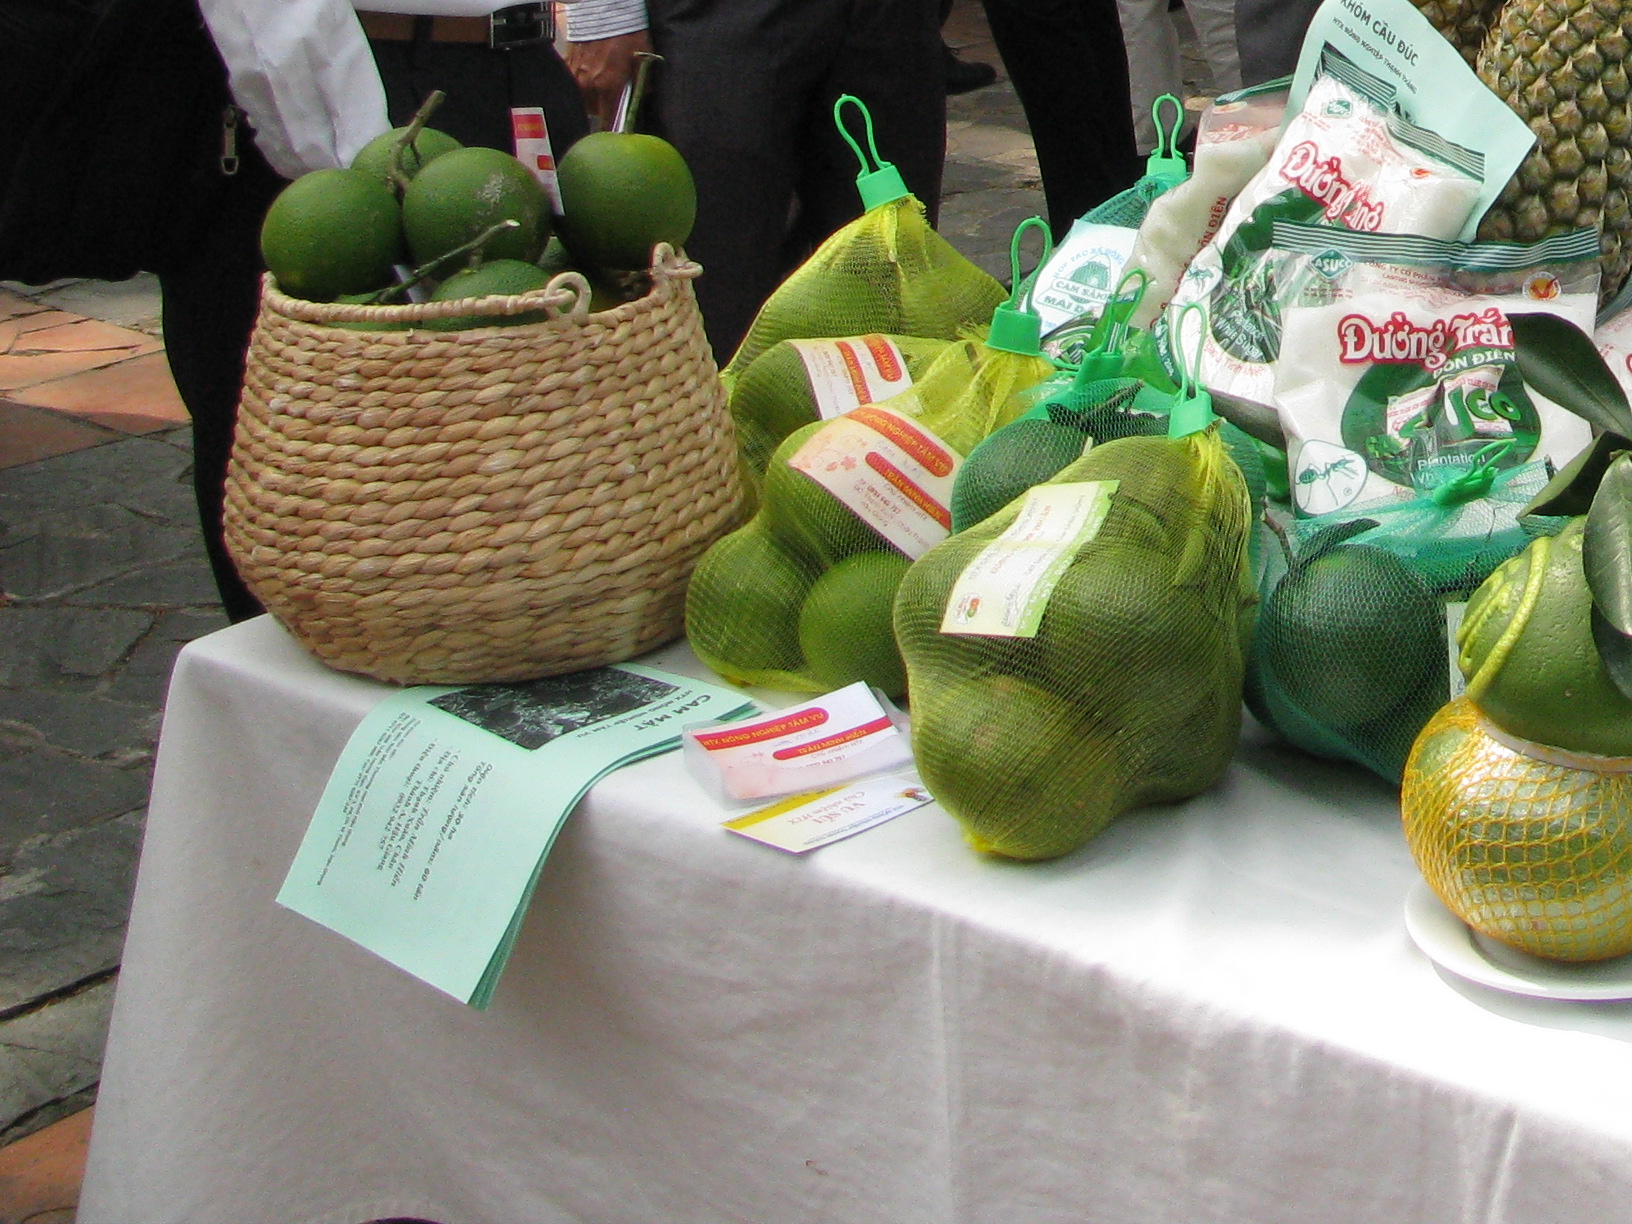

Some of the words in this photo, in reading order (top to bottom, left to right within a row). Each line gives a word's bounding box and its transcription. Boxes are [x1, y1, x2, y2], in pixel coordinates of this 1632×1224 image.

[1369, 15, 1401, 46] CẦU
[1392, 36, 1424, 66] ĐÚC
[1337, 305, 1451, 381] Đường
[671, 692, 712, 717] CAM
